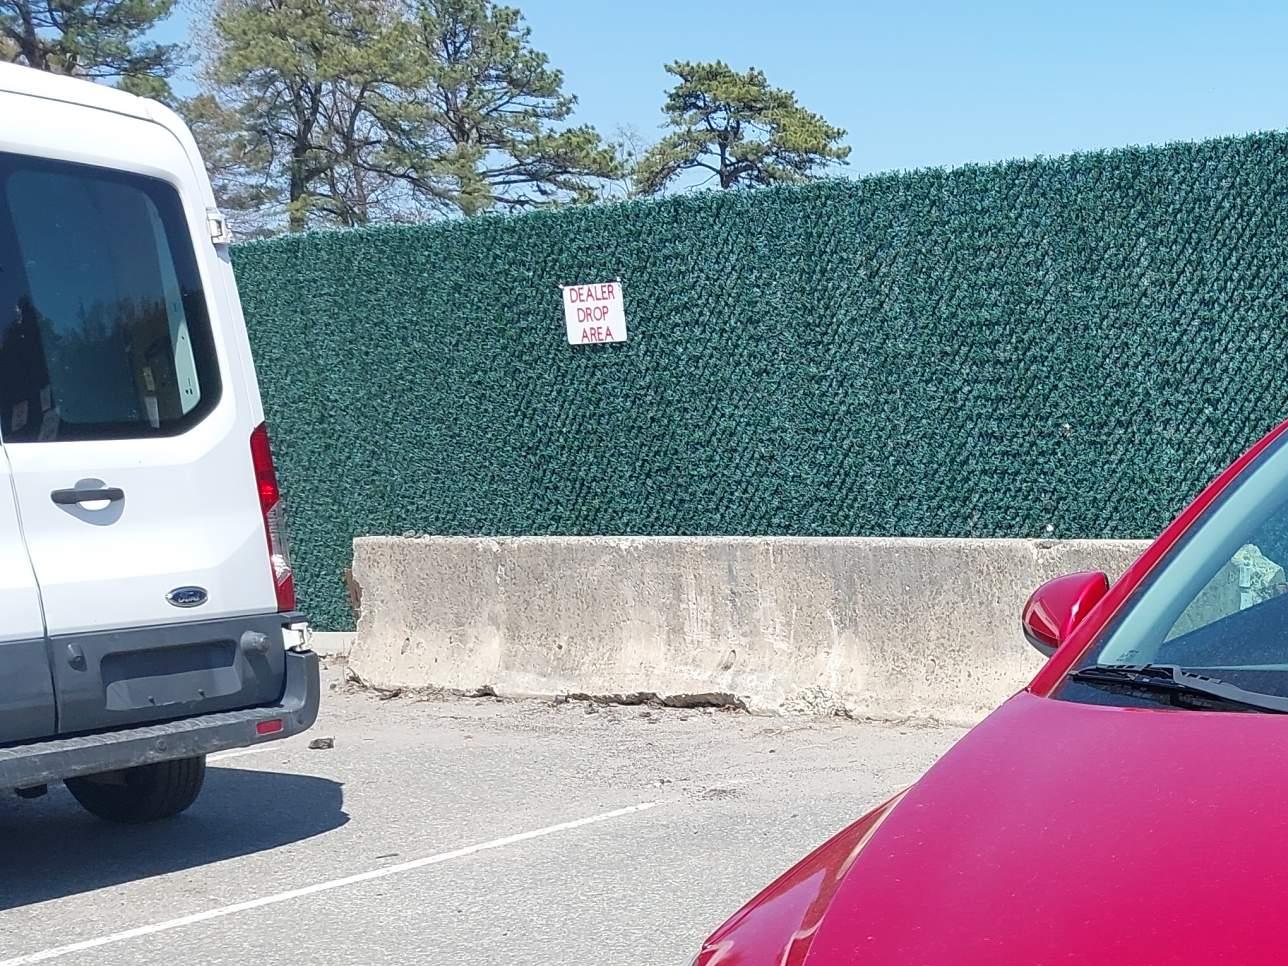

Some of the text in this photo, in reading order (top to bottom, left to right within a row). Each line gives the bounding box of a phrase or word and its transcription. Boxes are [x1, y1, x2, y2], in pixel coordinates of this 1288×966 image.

[569, 284, 615, 303] DEALER
[577, 305, 609, 323] DROP
[581, 326, 615, 343] AREA
